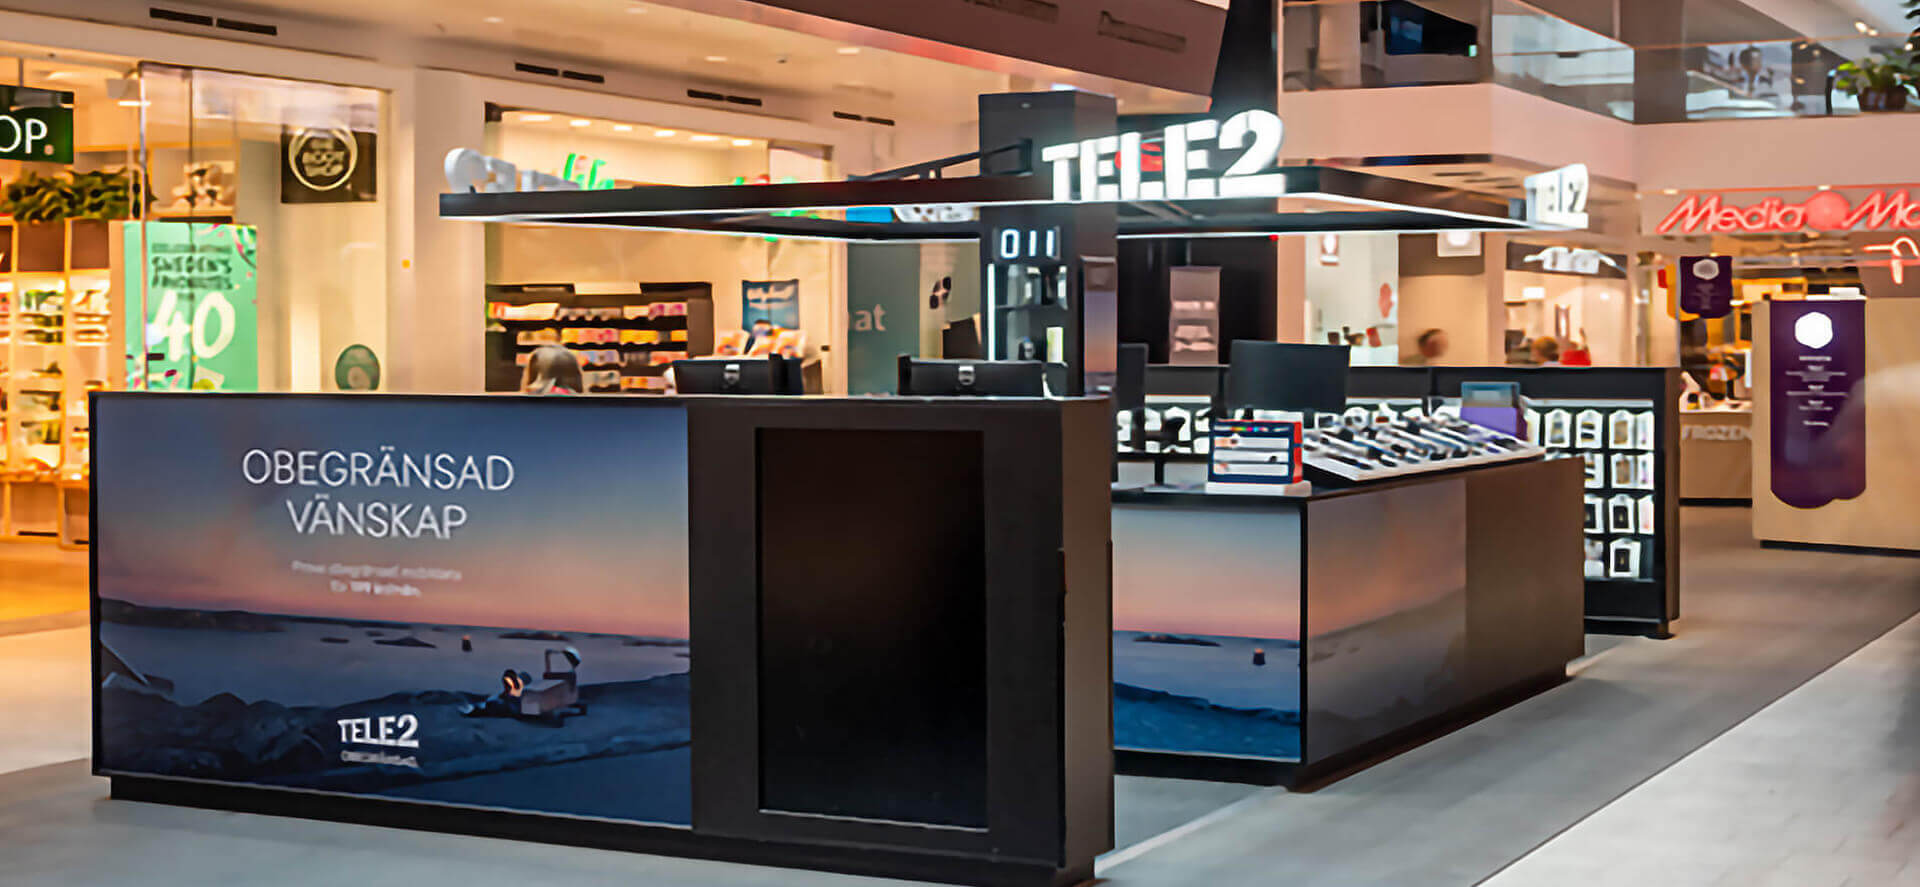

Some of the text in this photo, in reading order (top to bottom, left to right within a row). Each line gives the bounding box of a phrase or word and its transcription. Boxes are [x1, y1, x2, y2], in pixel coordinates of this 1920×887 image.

[1041, 109, 1286, 200] TELE2
[1656, 195, 1808, 234] Media
[146, 290, 235, 362] 40
[243, 445, 514, 491] OBEGRÄNSAD
[286, 493, 467, 540] VÄNSKAP
[337, 714, 419, 748] TELE2
